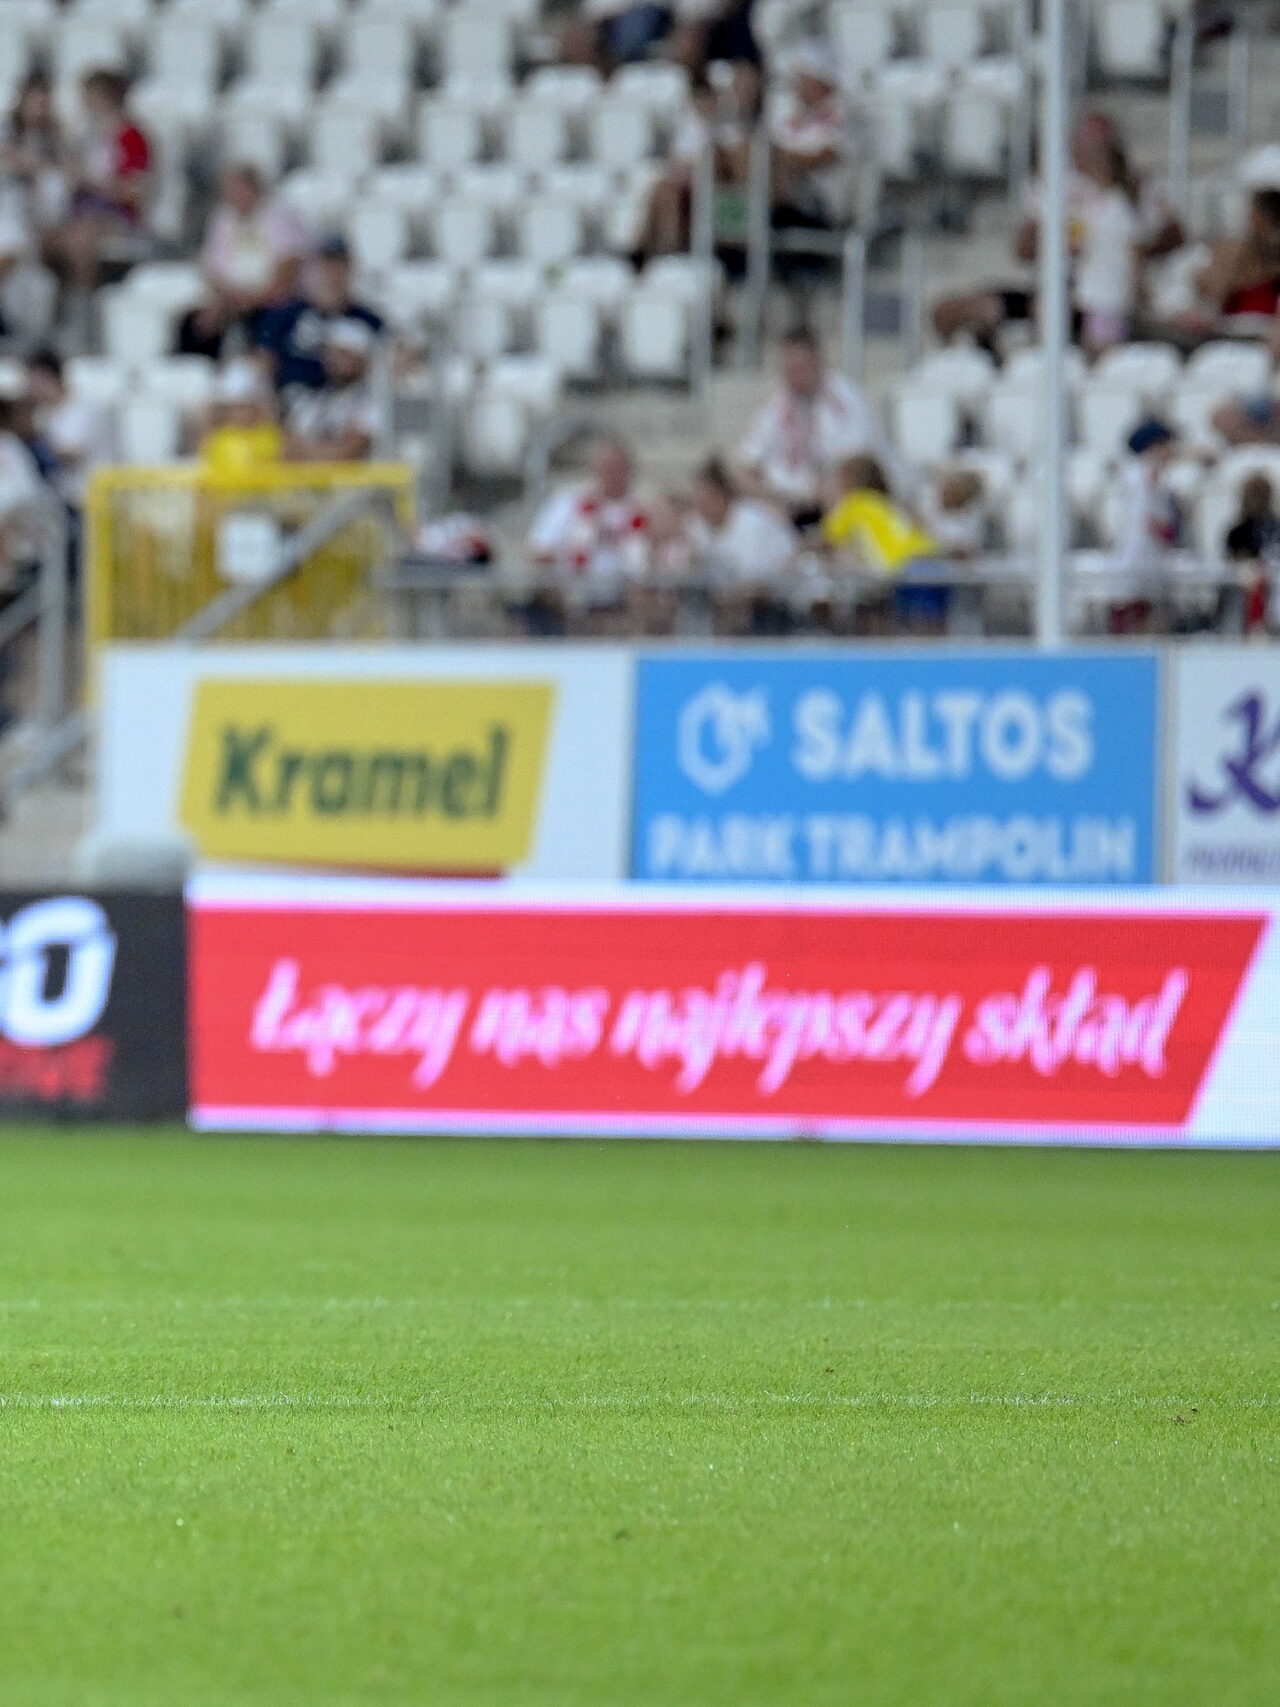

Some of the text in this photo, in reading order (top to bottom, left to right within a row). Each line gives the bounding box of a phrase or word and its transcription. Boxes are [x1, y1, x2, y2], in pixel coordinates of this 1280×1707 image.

[216, 722, 510, 818] Kramel
[793, 687, 1094, 780] SALTOS
[650, 814, 793, 877] PARK
[807, 814, 1138, 880] TRAMPOLIN
